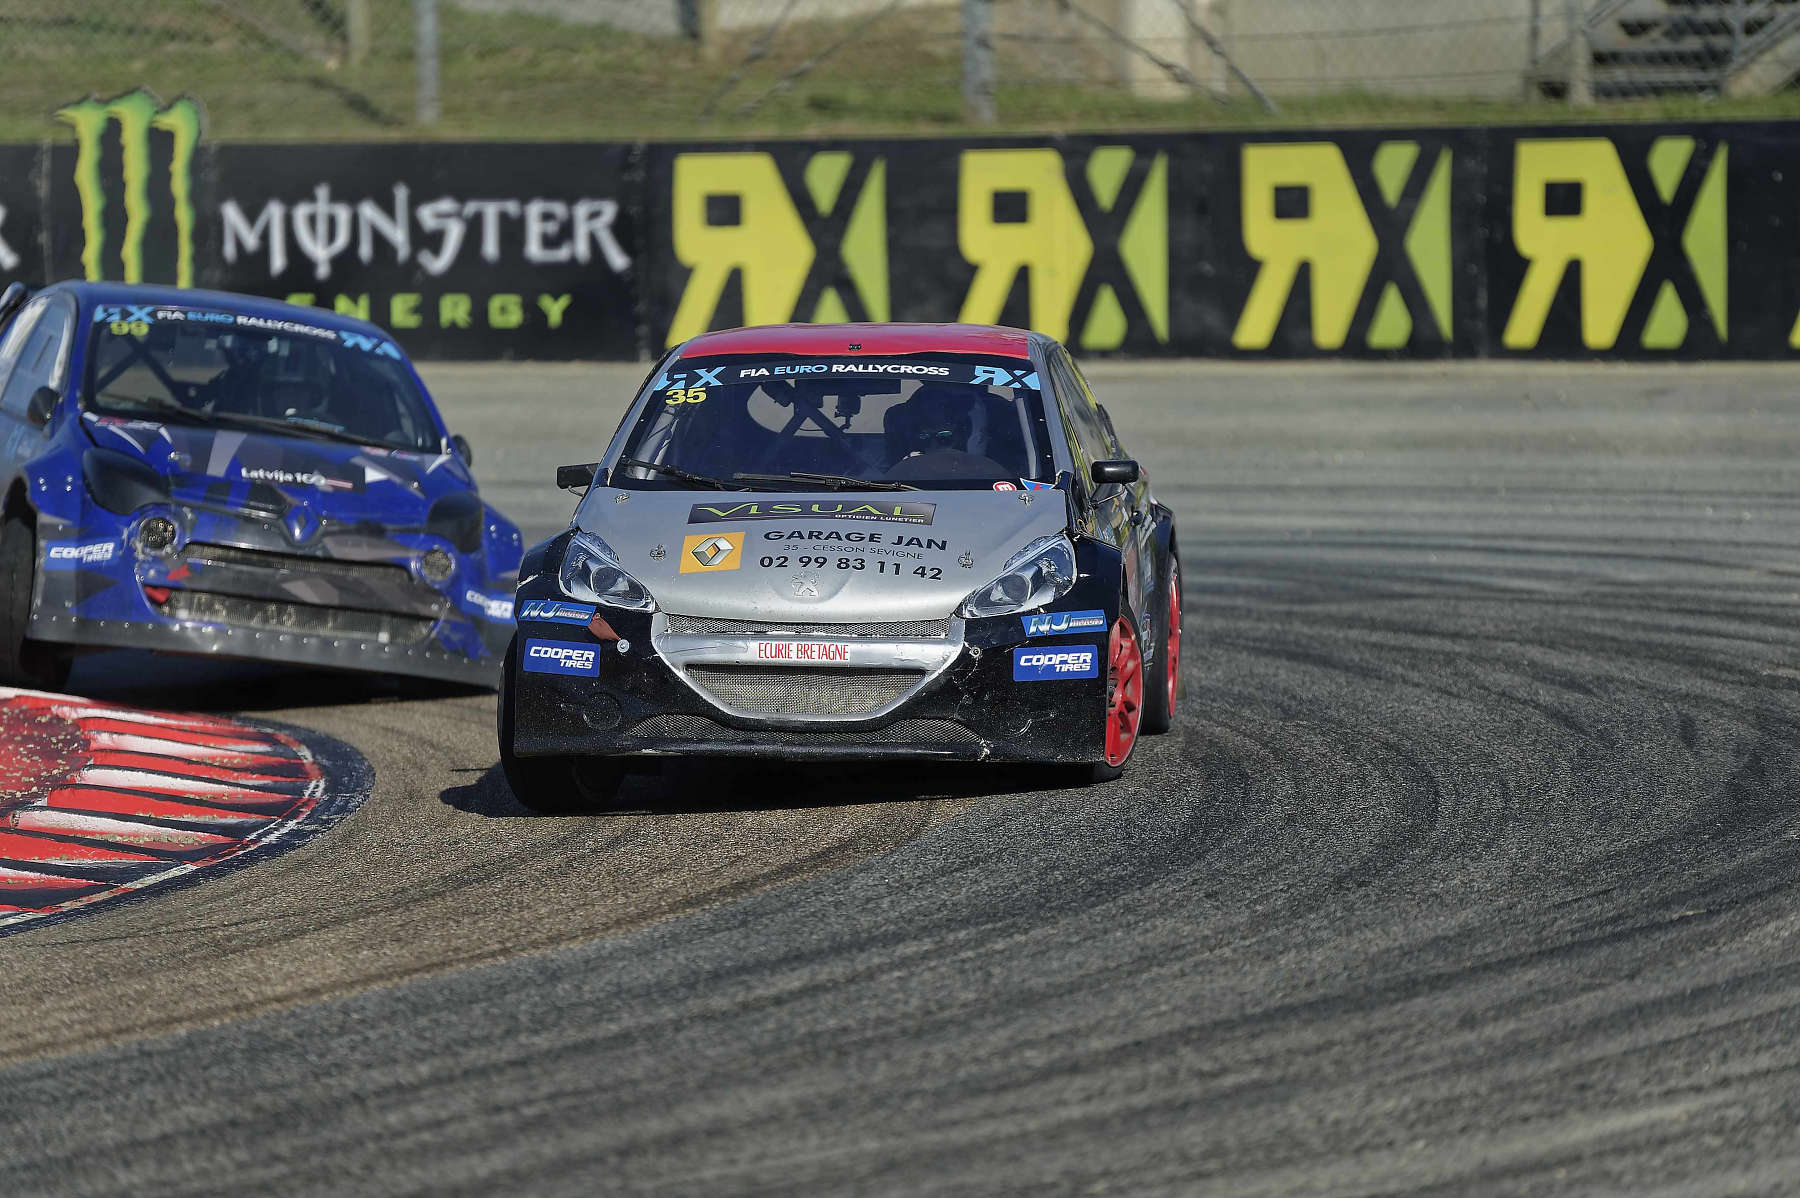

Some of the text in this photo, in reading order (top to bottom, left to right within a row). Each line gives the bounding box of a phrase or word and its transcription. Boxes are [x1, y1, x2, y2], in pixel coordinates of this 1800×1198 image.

[220, 183, 632, 281] MONSTER
[157, 310, 186, 320] FIA
[740, 367, 770, 378] FIA
[774, 364, 828, 375] EURO
[832, 364, 950, 376] RALLYCROSS
[665, 387, 707, 406] 35
[697, 502, 925, 517] VISUAL
[763, 530, 948, 551] GARAGE JAN
[812, 544, 866, 553] CESSON
[869, 547, 924, 560] SEVIGNE
[759, 555, 943, 581] 02 99 83 11 42
[1029, 614, 1071, 635] NJ
[529, 646, 595, 662] COOPER
[758, 642, 849, 661] ECURIE BRETAGNE
[1020, 652, 1092, 666] COOPER
[559, 659, 593, 669] TIRES
[1055, 663, 1091, 672] TIRES
